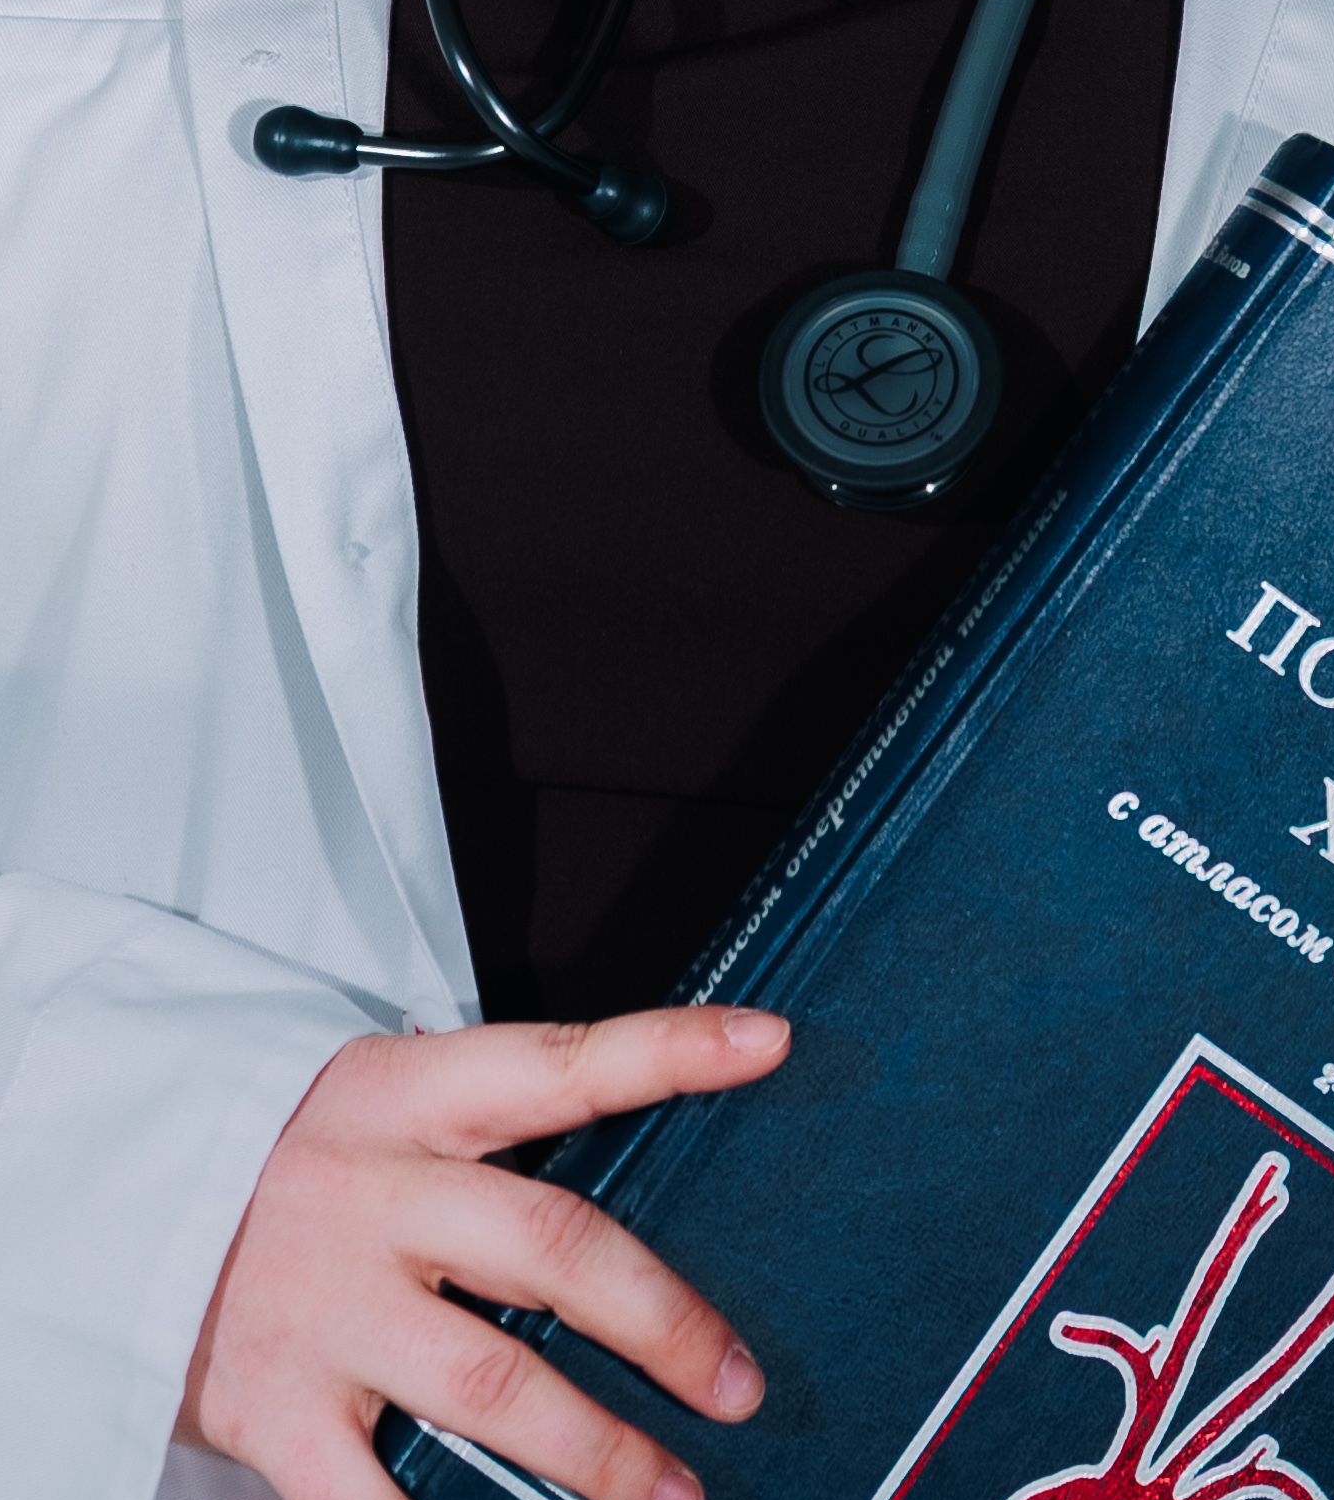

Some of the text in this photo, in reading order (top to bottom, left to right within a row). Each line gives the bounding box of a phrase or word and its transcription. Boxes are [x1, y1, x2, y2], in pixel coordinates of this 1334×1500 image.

[814, 315, 935, 369] LITTMANN
[839, 396, 944, 440] QUALITY
[689, 885, 782, 1008] тласом
[785, 639, 955, 880] оперативной
[957, 488, 1069, 640] техники
[1107, 791, 1141, 822] с
[1138, 814, 1334, 964] атласом
